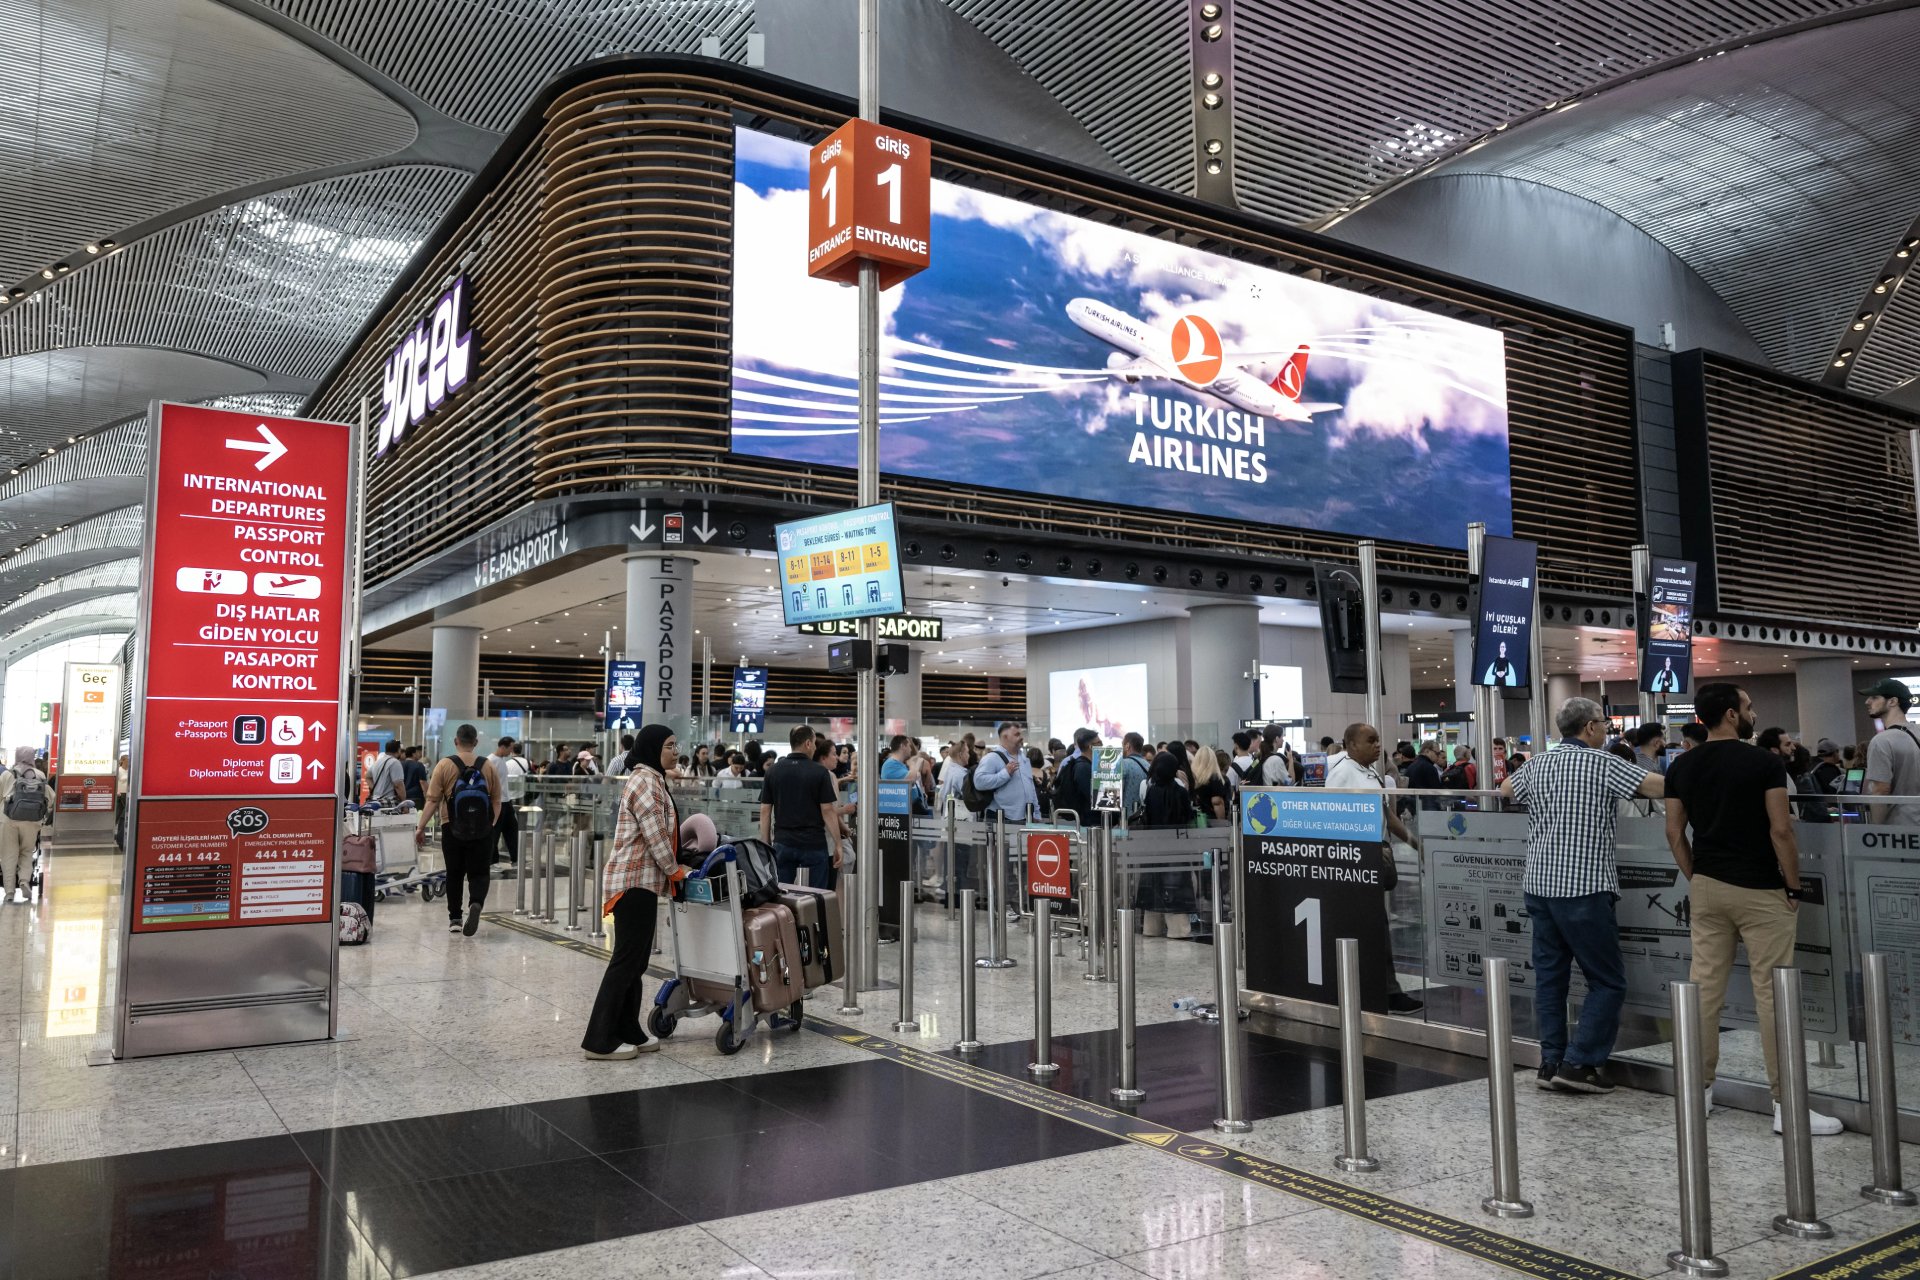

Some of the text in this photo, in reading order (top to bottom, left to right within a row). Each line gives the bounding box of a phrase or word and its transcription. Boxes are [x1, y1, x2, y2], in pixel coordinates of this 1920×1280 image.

[821, 140, 842, 164] GİRİŞ
[876, 136, 910, 159] GİRİŞ
[822, 166, 836, 228] 1
[877, 164, 901, 224] 1
[810, 226, 852, 262] ENTRANCE
[856, 226, 926, 254] ENTRANCE
[1084, 306, 1137, 336] TURKISH AIRLINES
[1129, 392, 1265, 446] TURKISH
[1128, 432, 1268, 484] AIRLINES
[184, 474, 326, 500] INTERNATIONAL
[212, 499, 326, 522] DEPARTURES
[234, 525, 325, 544] PASSPORT
[844, 529, 864, 540] WAITING
[864, 526, 876, 536] TIME
[240, 548, 324, 567] CONTROL
[490, 528, 558, 584] E-PASAPORT
[870, 546, 881, 558] 1-5
[216, 604, 320, 622] DIŞ HATLAR
[1496, 614, 1526, 624] UÇUŞLAR
[200, 623, 318, 644] GİDEN YOLCU
[1492, 623, 1518, 634] DİLERİZ
[224, 652, 318, 668] PASAPORT
[82, 673, 107, 685] Geç
[232, 674, 317, 690] KONTROL
[179, 720, 228, 730] e-Pasaport
[175, 730, 228, 740] e-Passports
[223, 759, 264, 768] Diplomat
[190, 768, 239, 778] Diplomatic
[1494, 770, 1504, 779] xit
[1282, 800, 1375, 813] OTHER NATIONALITIES
[233, 814, 263, 826] SOS
[1323, 821, 1376, 832] VATANDAŞLARI
[879, 830, 908, 840] NTRANCE
[1862, 832, 1920, 849] OTHE
[158, 852, 220, 862] 444 1 442
[256, 850, 277, 859] 444
[292, 849, 314, 858] 442
[1262, 842, 1362, 863] PASAPORT GİRİŞ
[1454, 855, 1493, 866] GÜVENLİK
[1248, 860, 1378, 884] PASSPORT ENTRANCE
[1468, 869, 1504, 880] SECURITY
[1032, 882, 1066, 895] Girilmez
[1294, 898, 1322, 986] 1
[1233, 1156, 1274, 1170] Bagaj
[1272, 1166, 1346, 1194] araçlarının
[1344, 1192, 1388, 1207] girişi
[1384, 1202, 1460, 1230] yasaktır!
[1470, 1230, 1534, 1254] Trolleys
[1534, 1253, 1565, 1264] are
[1567, 1263, 1603, 1276] not
[1248, 1170, 1284, 1184] Yolcu
[1284, 1182, 1328, 1197] harici
[1323, 1196, 1381, 1216] girmek
[1378, 1213, 1456, 1241] yasaktır!
[1464, 1241, 1556, 1273] Passenger
